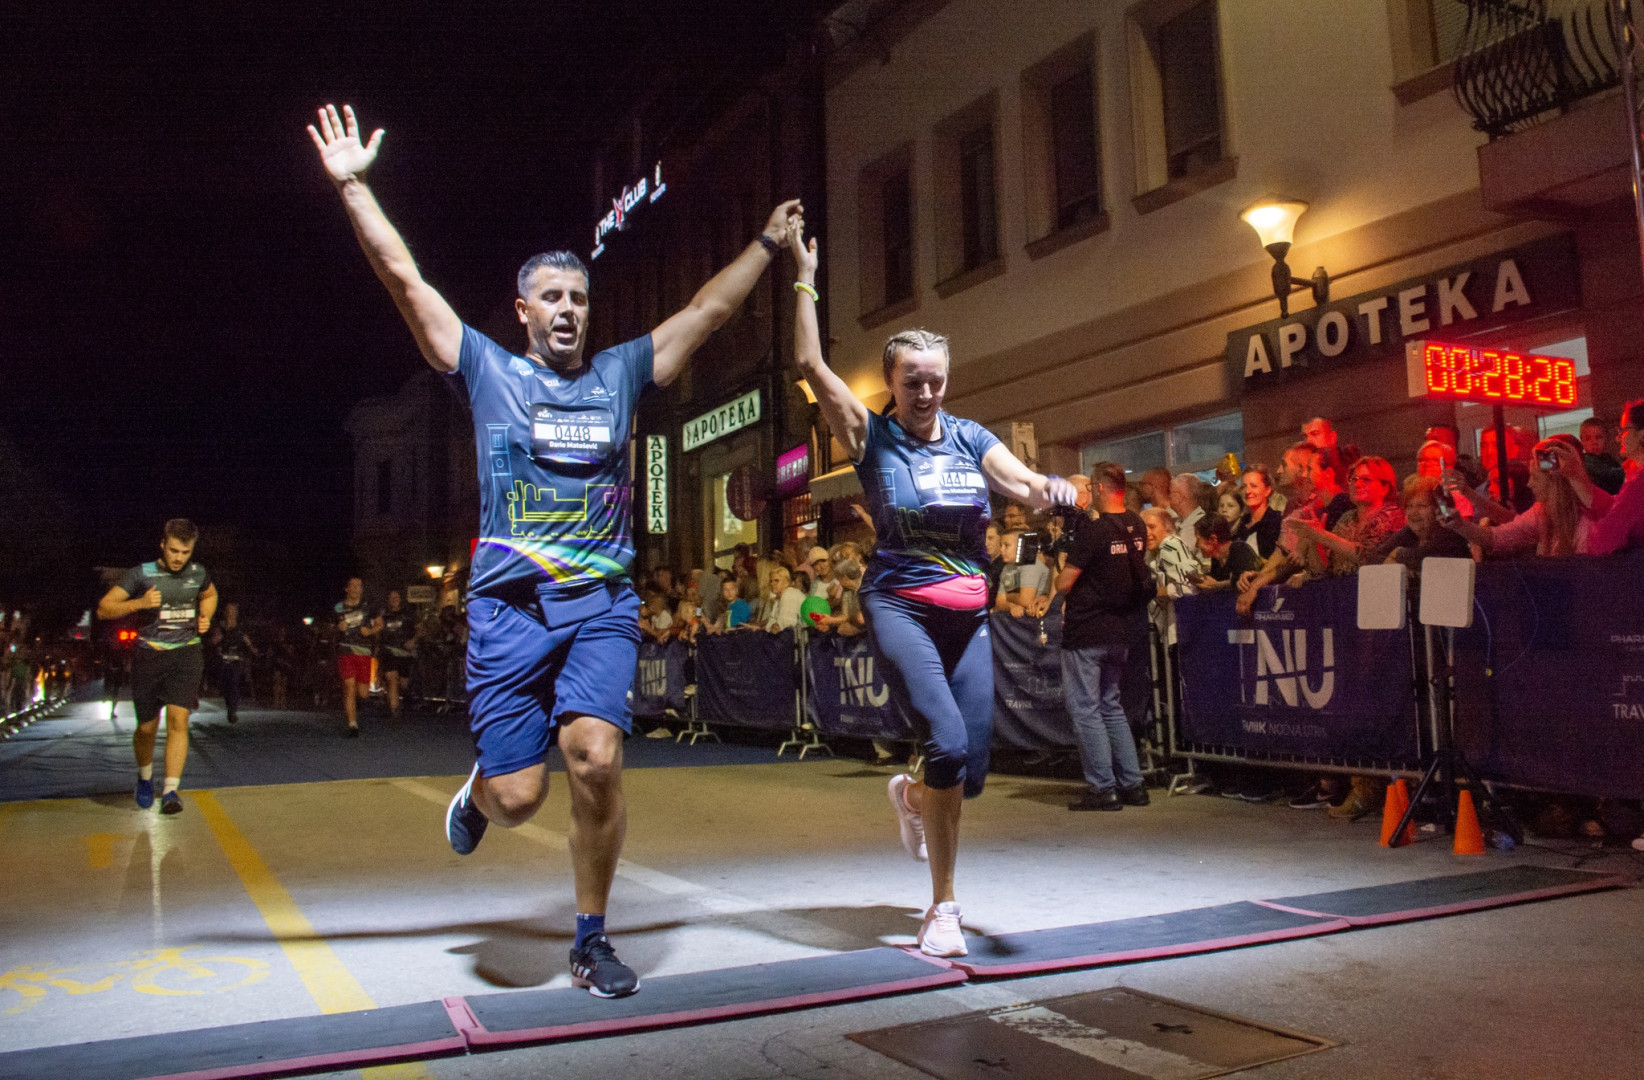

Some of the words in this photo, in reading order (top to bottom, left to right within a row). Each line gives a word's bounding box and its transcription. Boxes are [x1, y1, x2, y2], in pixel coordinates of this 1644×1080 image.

[598, 210, 615, 236] THE
[625, 178, 647, 212] CLUB
[1243, 258, 1531, 378] APOTEKA
[1426, 345, 1574, 404] 00:28:28
[555, 425, 591, 442] 0448
[692, 397, 756, 444] APOTEKA
[650, 436, 664, 532] APOTEKA
[638, 659, 667, 697] TNU
[834, 656, 889, 707] TNU
[1227, 628, 1335, 710] TNU
